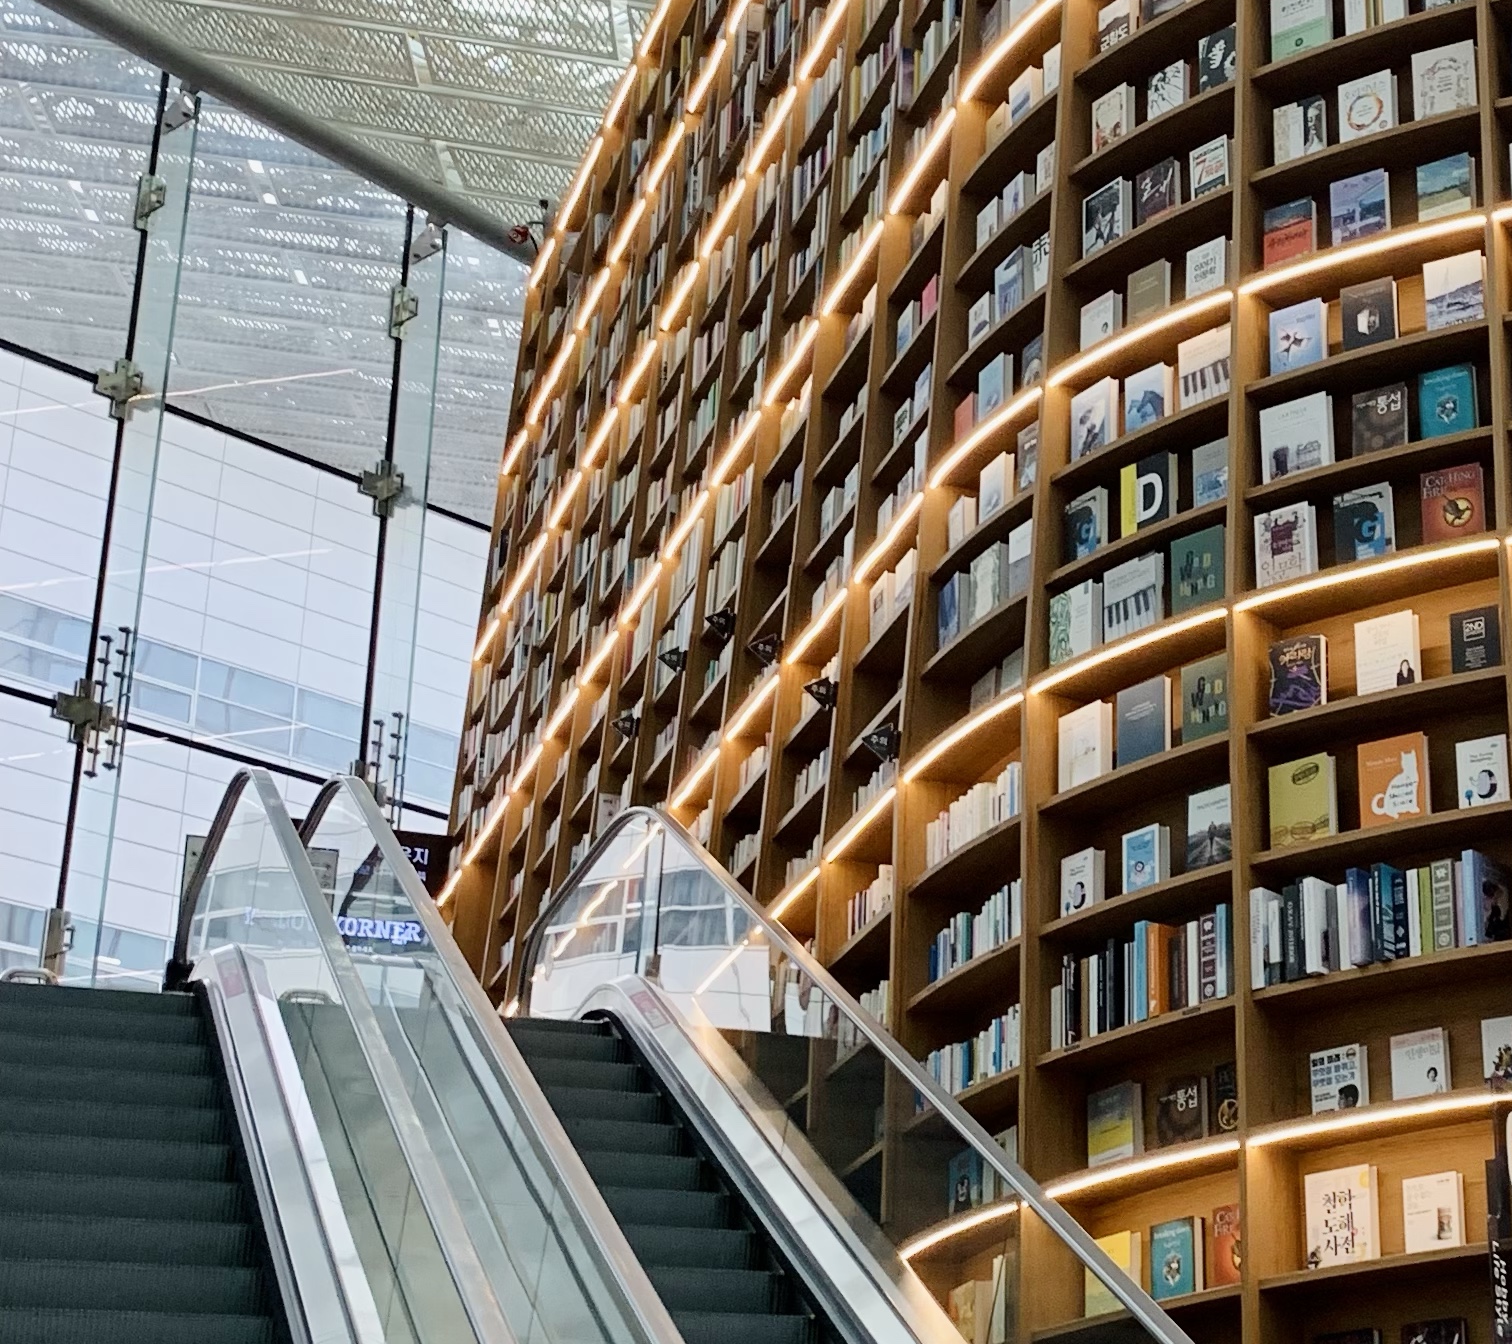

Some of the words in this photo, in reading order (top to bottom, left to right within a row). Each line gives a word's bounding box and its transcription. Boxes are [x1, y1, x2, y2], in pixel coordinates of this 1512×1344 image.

[1375, 391, 1402, 415] 통섭
[1175, 1085, 1199, 1112] 통섭
[1321, 1188, 1356, 1216] 철학
[1323, 1234, 1356, 1256] 사전
